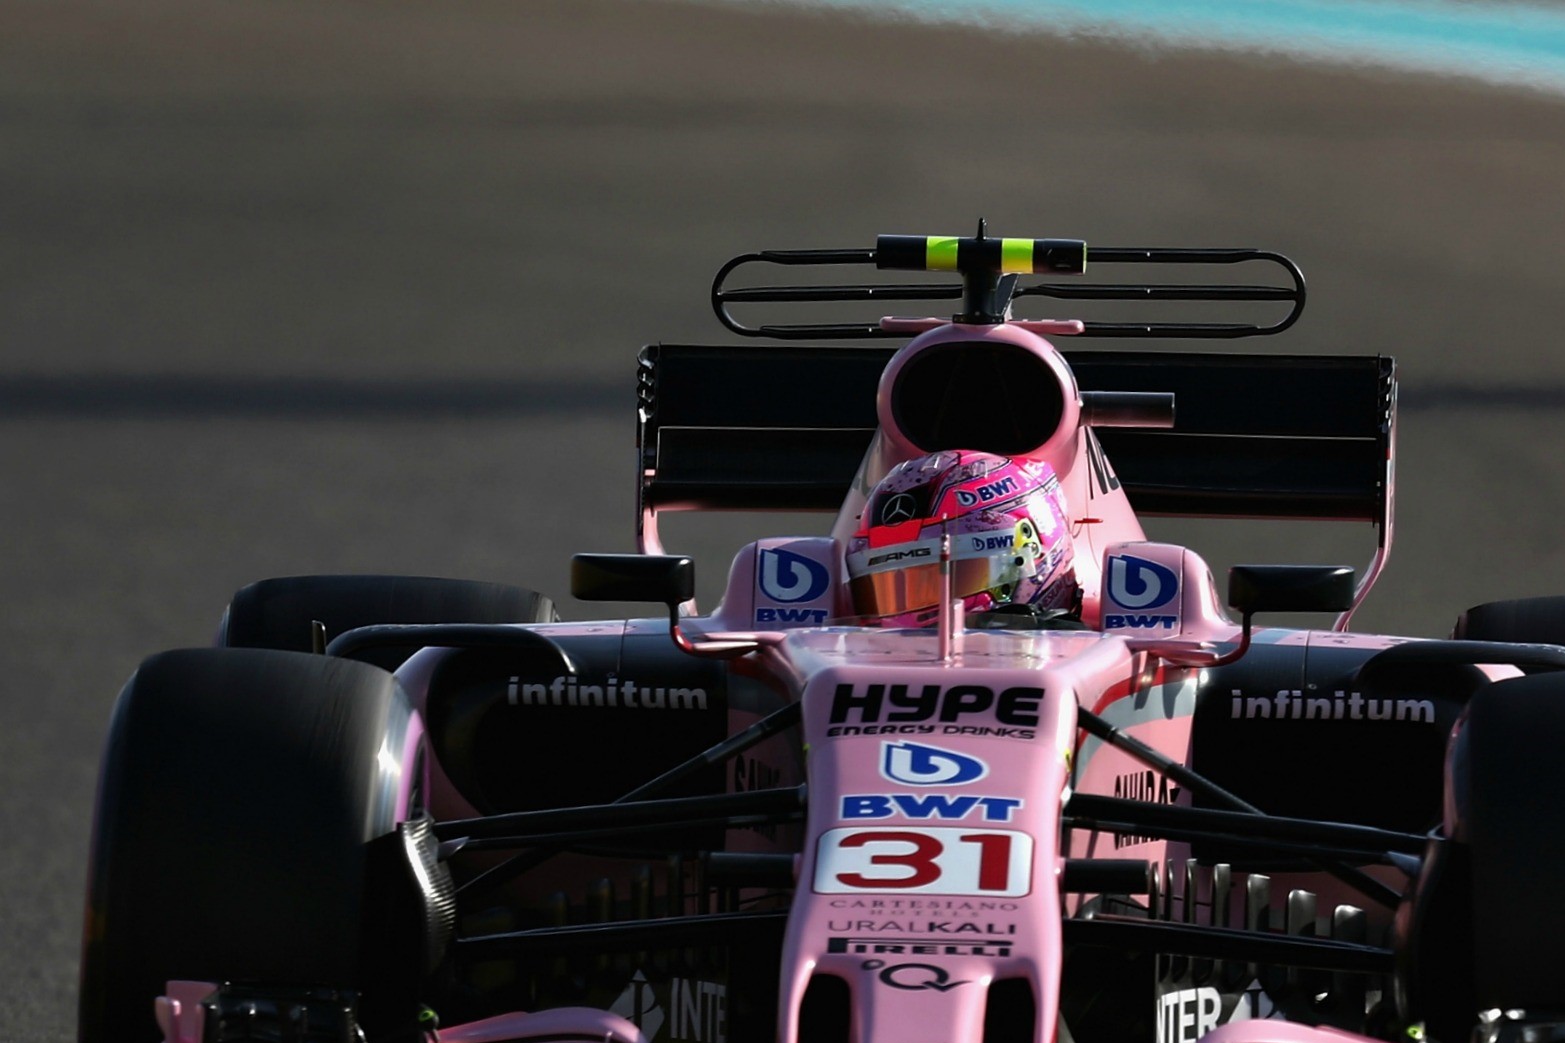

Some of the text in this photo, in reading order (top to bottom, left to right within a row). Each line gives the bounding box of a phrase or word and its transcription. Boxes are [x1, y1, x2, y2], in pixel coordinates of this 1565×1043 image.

[976, 477, 1019, 502] BWT
[986, 534, 1014, 550] BWT
[756, 608, 828, 624] BWT
[1105, 614, 1177, 629] BWT
[507, 675, 708, 711] infinitum
[829, 683, 1045, 727] HYPE
[1230, 689, 1435, 724] infinitum
[826, 725, 1036, 740] ENERGY DRINKS
[841, 794, 1021, 821] BWT
[835, 831, 1012, 892] 31
[829, 899, 1019, 912] CARTESIANO
[869, 909, 980, 918] HOTELS
[828, 920, 1016, 936] URALKALI
[827, 937, 1014, 958] PIRELLI
